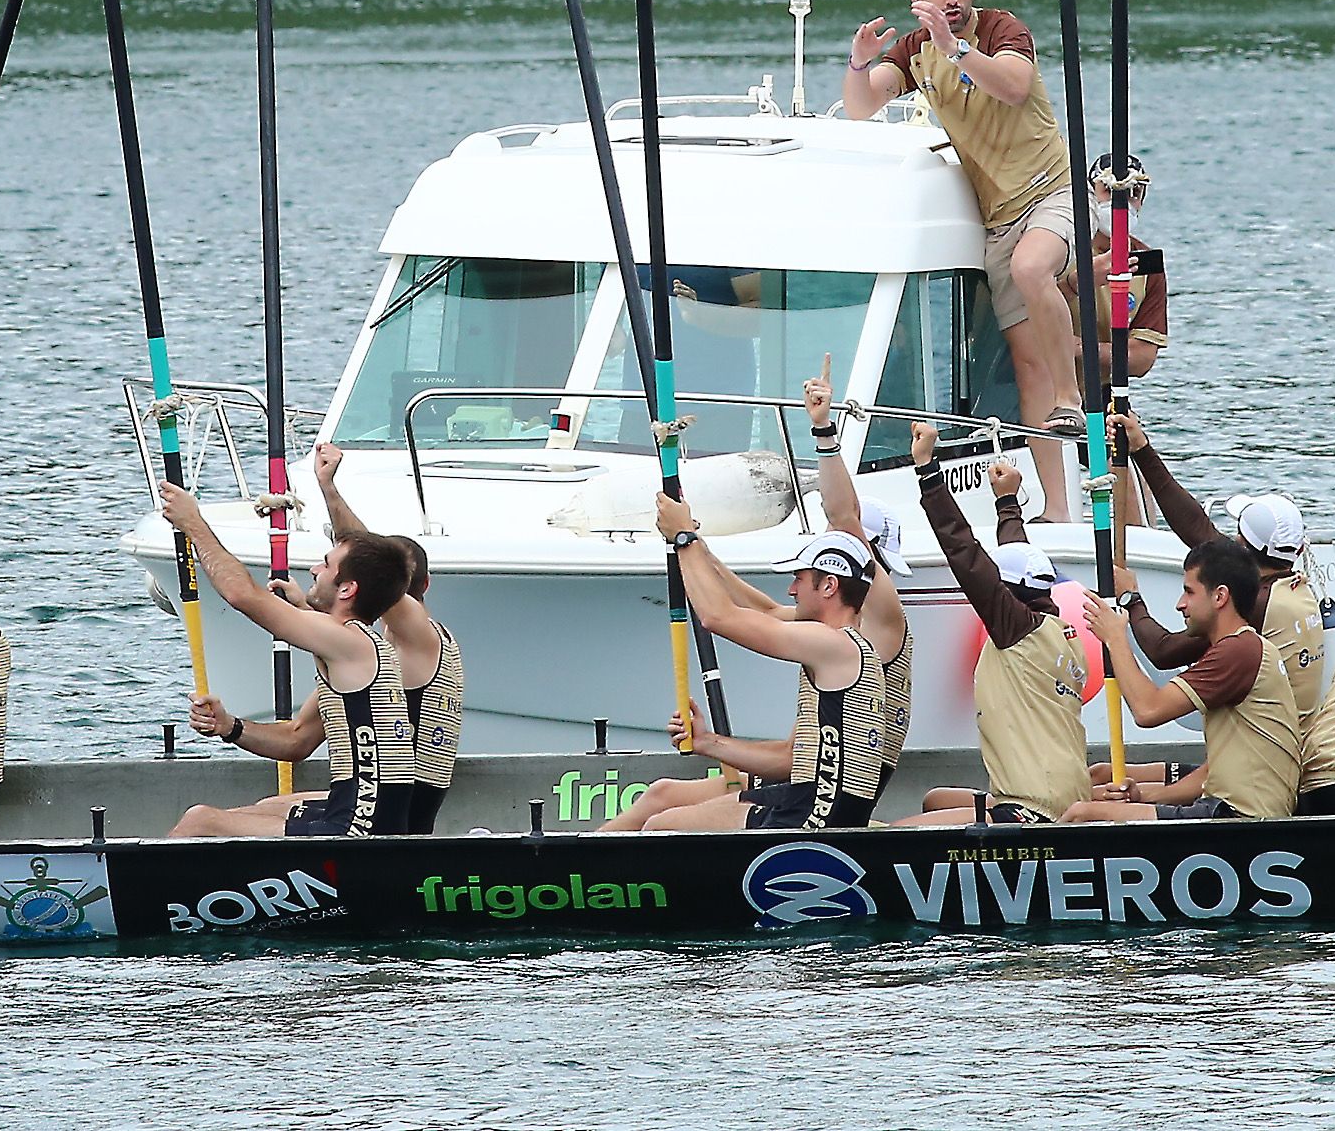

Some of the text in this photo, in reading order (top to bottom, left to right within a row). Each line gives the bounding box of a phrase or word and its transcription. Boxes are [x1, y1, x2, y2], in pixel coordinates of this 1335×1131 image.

[412, 377, 456, 385] GARMIN
[416, 873, 668, 919] frigolan
[893, 851, 1313, 924] VIVEROS
[309, 905, 349, 921] CARE
